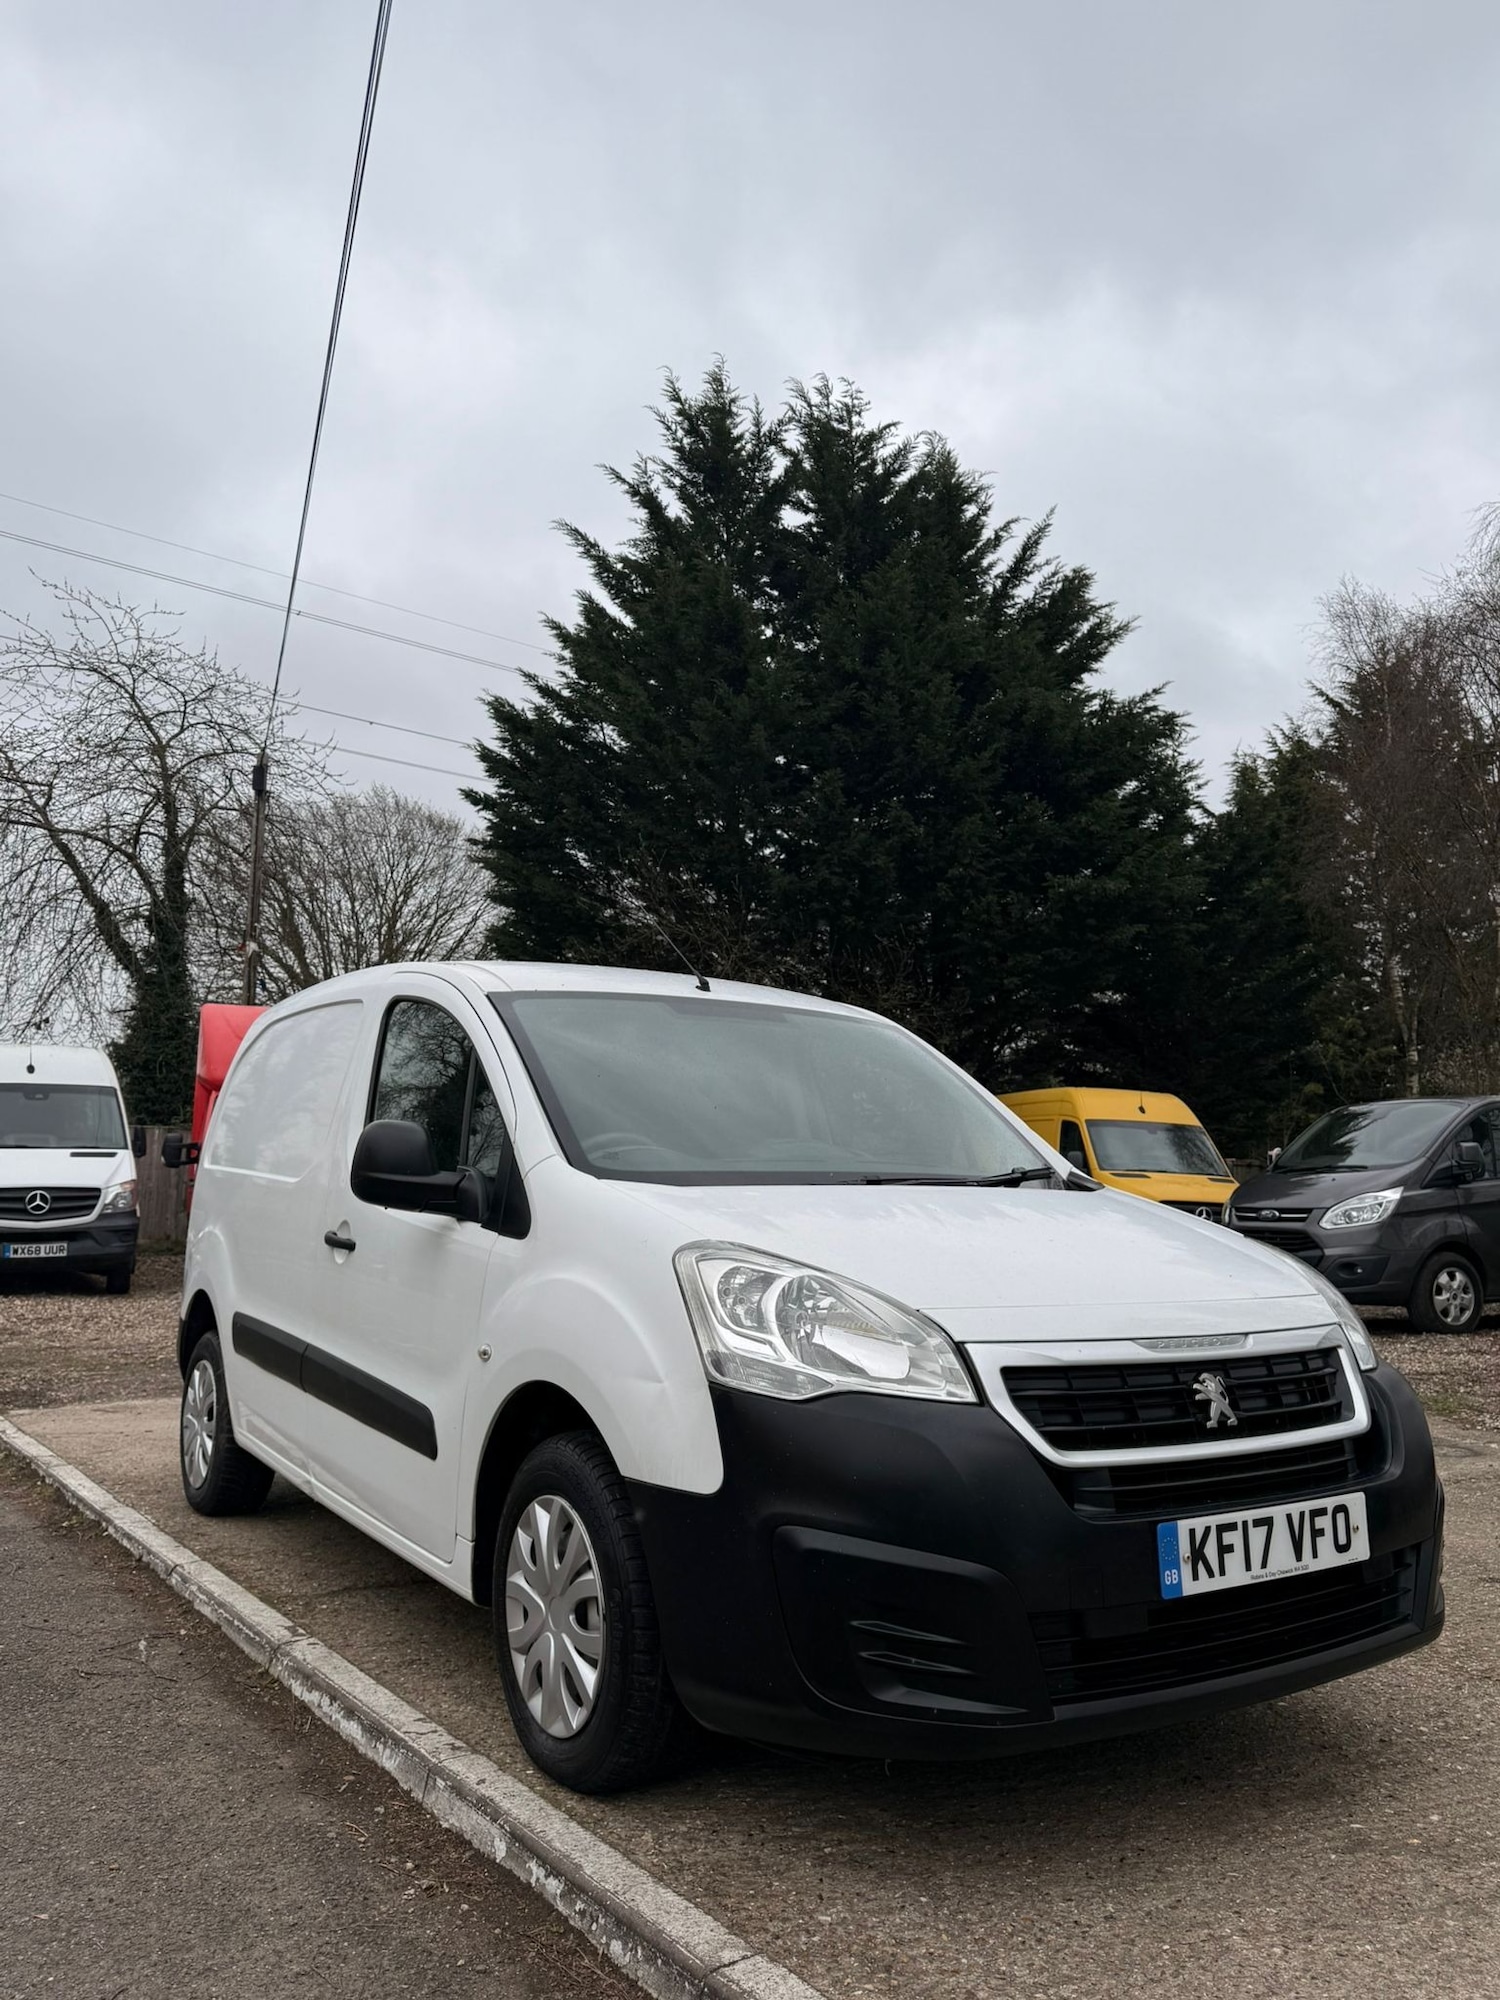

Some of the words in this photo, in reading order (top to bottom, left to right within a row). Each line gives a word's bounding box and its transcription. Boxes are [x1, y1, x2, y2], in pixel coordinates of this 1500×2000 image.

[12, 1245, 41, 1256] WX68
[44, 1245, 66, 1255] UUR
[1157, 1336, 1231, 1348] PEUGEOT
[1188, 1516, 1275, 1582] KF17
[1285, 1503, 1352, 1563] VFO
[1164, 1569, 1179, 1585] GB
